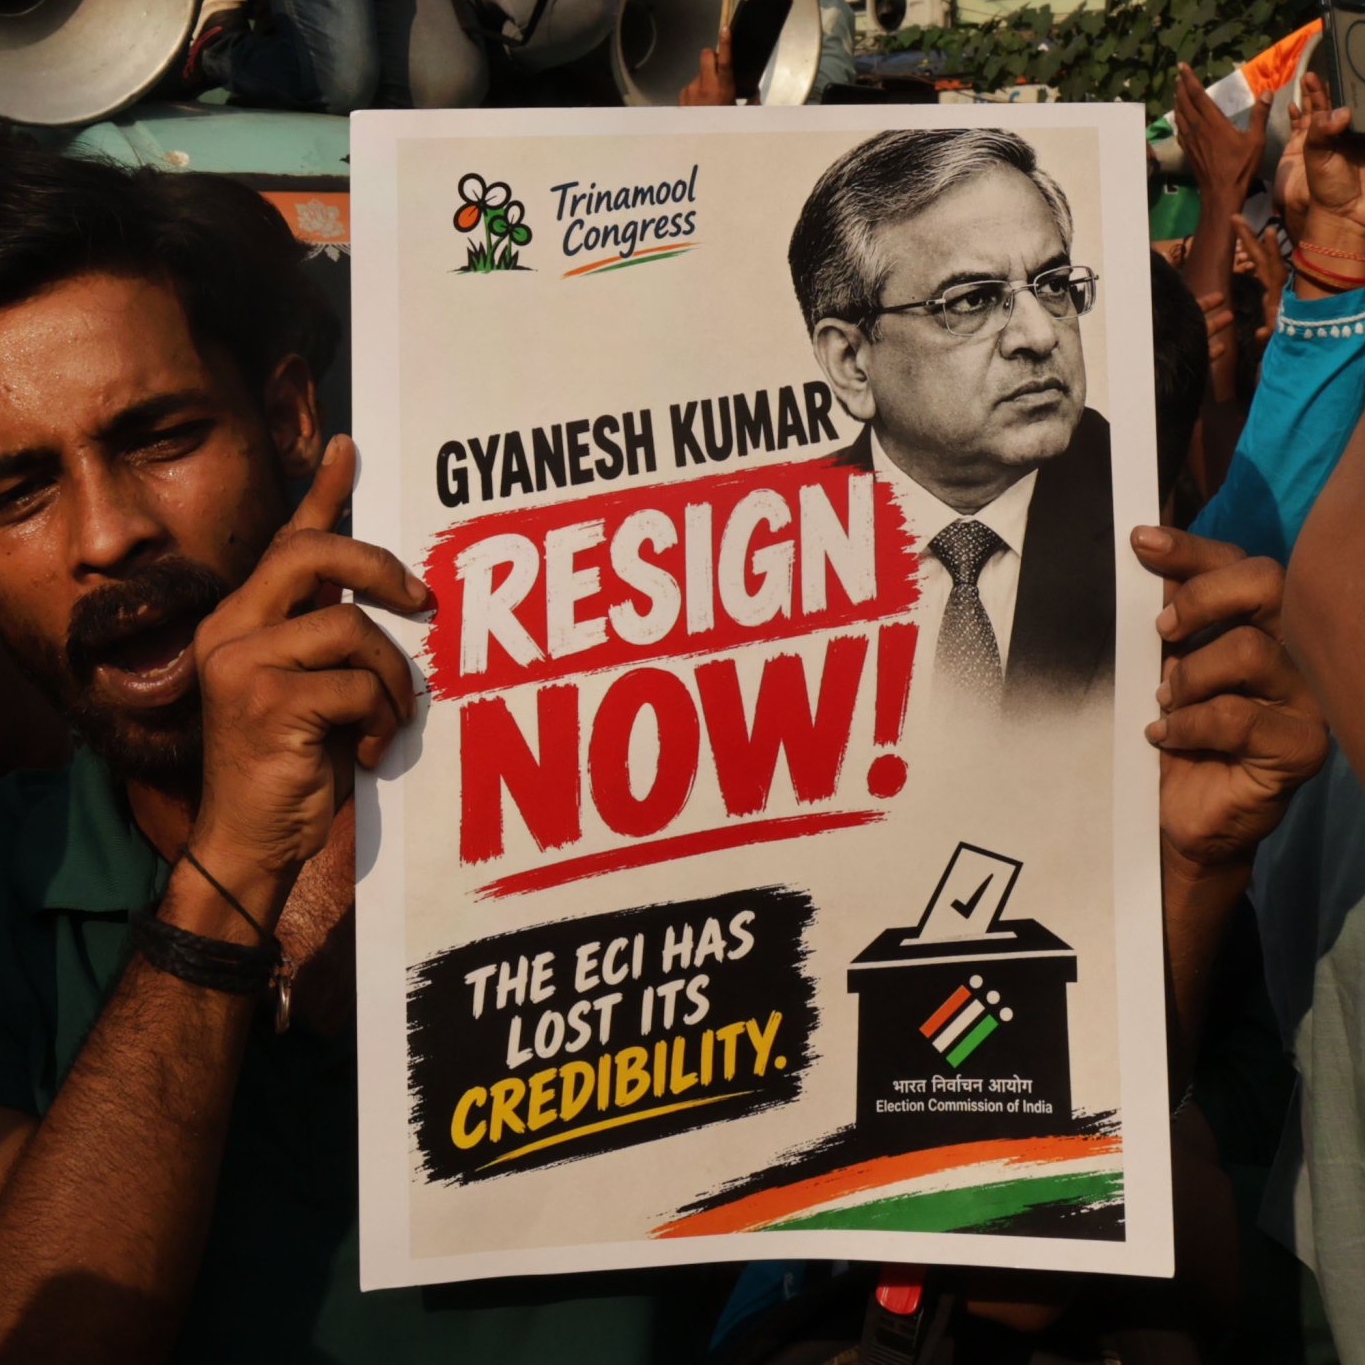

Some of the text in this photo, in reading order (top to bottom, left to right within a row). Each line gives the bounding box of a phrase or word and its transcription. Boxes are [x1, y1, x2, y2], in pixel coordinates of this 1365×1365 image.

[550, 164, 699, 223] Trinamool
[561, 211, 697, 259] Congress
[436, 380, 839, 508] GYANESH KUMAR
[457, 473, 878, 677] RESIGN
[459, 621, 920, 867] NOW!
[464, 908, 757, 1021] THE ECI HAS
[503, 972, 711, 1071] LOST ITS
[449, 1009, 789, 1151] CREDIBILITY.
[875, 1098, 1053, 1114] Election Commission of India
[892, 1074, 1033, 1094] भारत निर्वाचन आयोग
